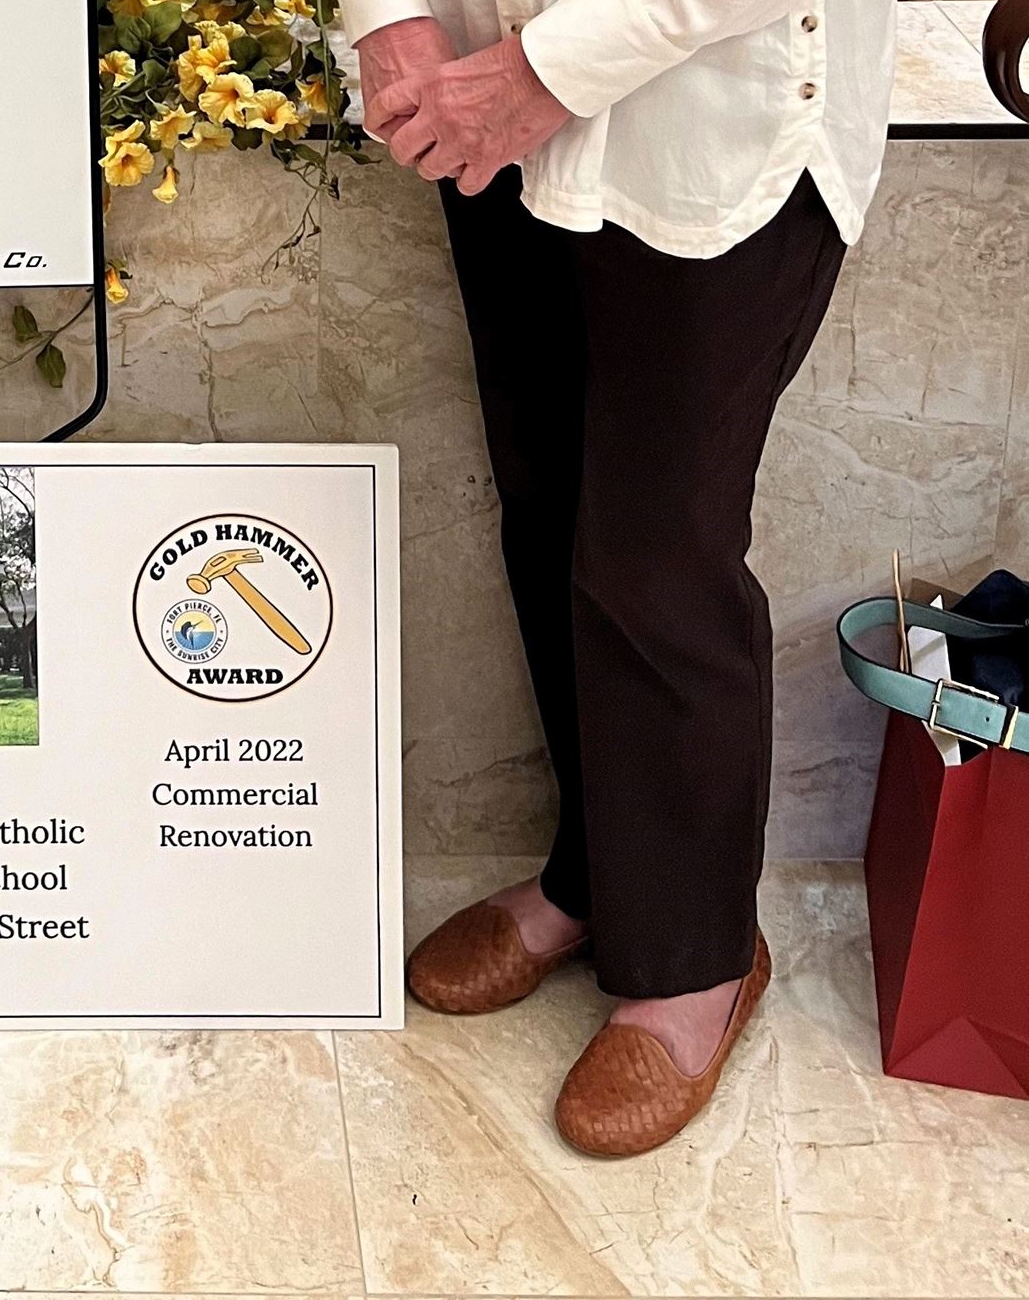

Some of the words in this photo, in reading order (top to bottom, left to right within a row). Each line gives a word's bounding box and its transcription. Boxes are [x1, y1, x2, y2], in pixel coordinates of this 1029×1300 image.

[149, 529, 208, 581] GOLD
[215, 524, 319, 591] HAMMER
[166, 606, 182, 624] FORT
[166, 637, 177, 651] THE
[177, 649, 210, 661] SUNRISE
[210, 637, 223, 653] CITY
[186, 668, 283, 685] AWARD
[164, 738, 230, 769] April
[238, 739, 304, 762] 2022
[152, 782, 318, 806] Commercial
[159, 824, 313, 847] Renovation
